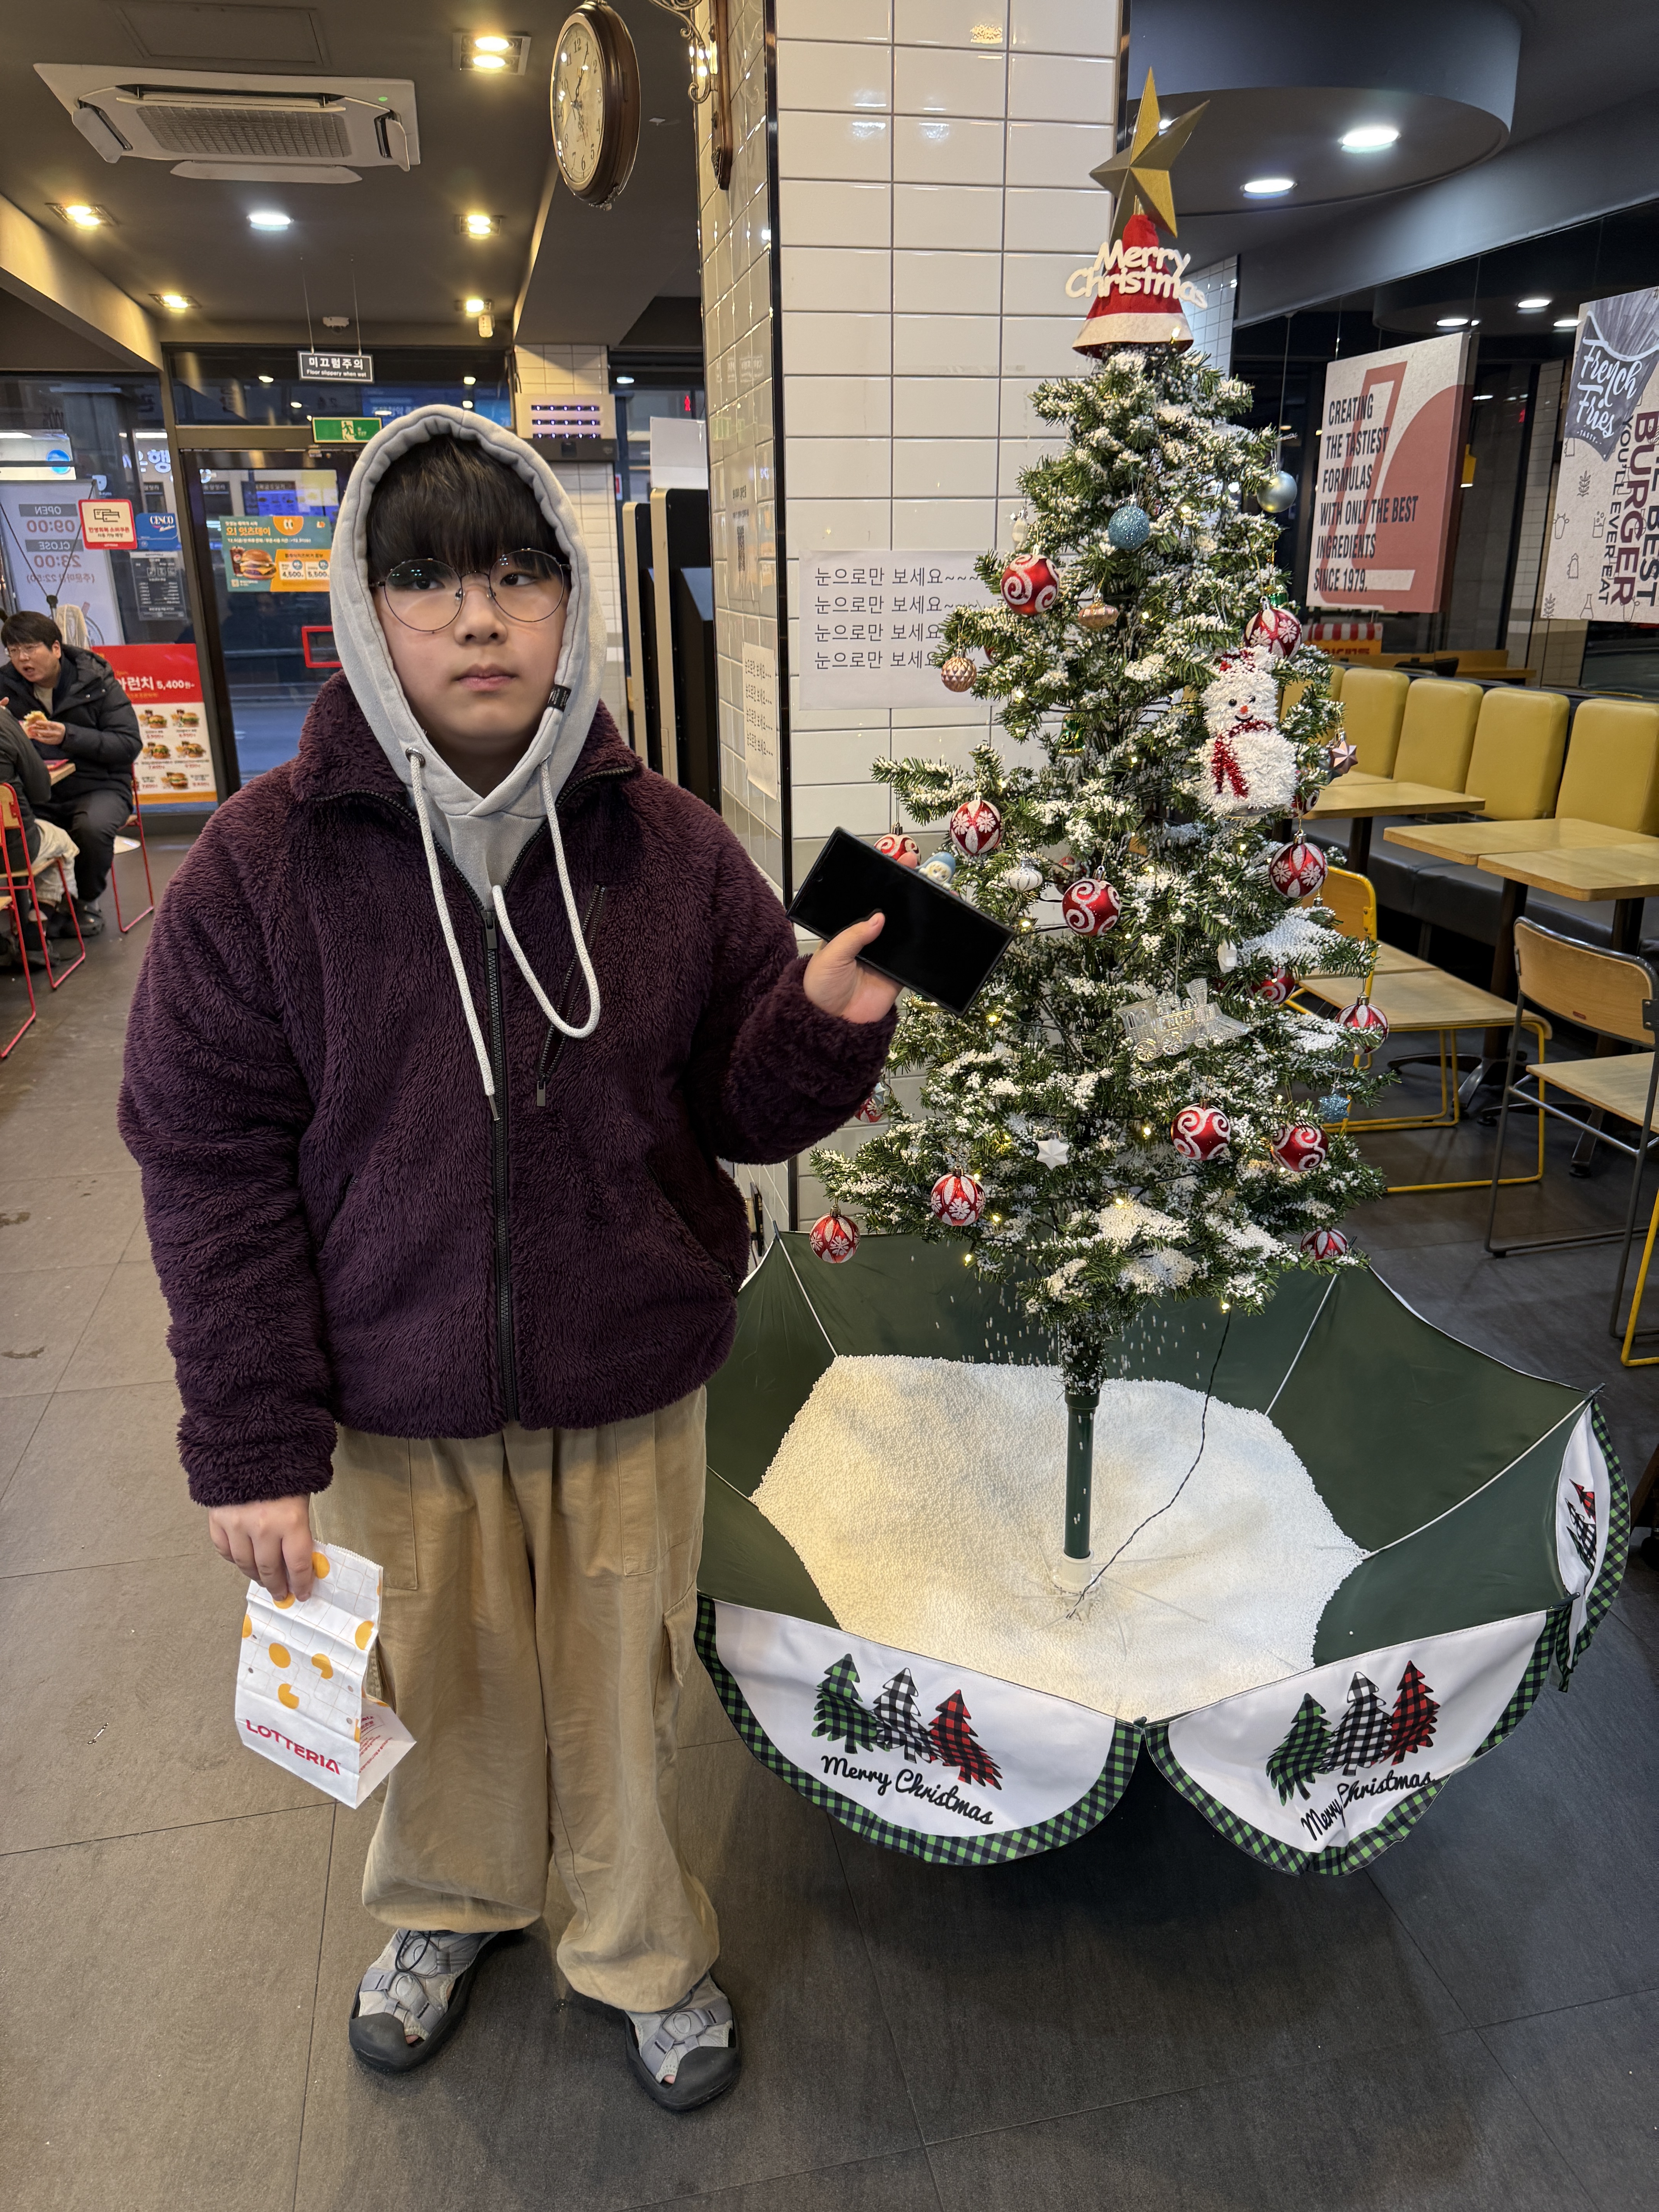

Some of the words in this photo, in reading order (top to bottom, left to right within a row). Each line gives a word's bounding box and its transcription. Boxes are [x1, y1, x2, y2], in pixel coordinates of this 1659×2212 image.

[574, 38, 581, 53] 12
[593, 59, 597, 74] 2
[565, 133, 568, 148] 8
[596, 118, 600, 134] 4
[572, 152, 576, 170] 7
[581, 154, 585, 171] 6
[591, 143, 594, 159] 5
[1093, 239, 1191, 280] Merry
[1065, 266, 1208, 309] Christmas
[309, 357, 363, 370] 미끄럼주의
[1580, 337, 1642, 407] French
[1328, 393, 1374, 426] CREATING
[1577, 382, 1614, 438] Fries
[1326, 435, 1342, 460] THE
[1346, 427, 1389, 457] TASTIEST
[1613, 416, 1634, 496] YOU'LL
[1322, 464, 1372, 493] FORMULAS
[1320, 500, 1342, 526] WITH
[1345, 499, 1369, 525] ONLY
[1371, 498, 1389, 524] THE
[1391, 495, 1418, 522] BEST
[1611, 411, 1659, 605] BURGER
[1605, 502, 1621, 558] EVER
[1316, 533, 1376, 559] INGREDIENTS
[815, 567, 885, 586] 눈으로만
[892, 567, 978, 586] 보세요~~~
[1314, 568, 1340, 591] SINCE
[1343, 568, 1367, 592] 1979.
[1598, 565, 1613, 605] EAT
[815, 595, 884, 614] 눈으로만
[815, 623, 883, 642] 눈으로만
[815, 650, 883, 670] 눈으로만
[246, 1719, 340, 1775] LOTTERIA
[821, 1755, 891, 1796] Merry
[895, 1768, 994, 1825] Christmas
[1300, 1798, 1346, 1841] Merry
[1337, 1769, 1435, 1808] Christmas
